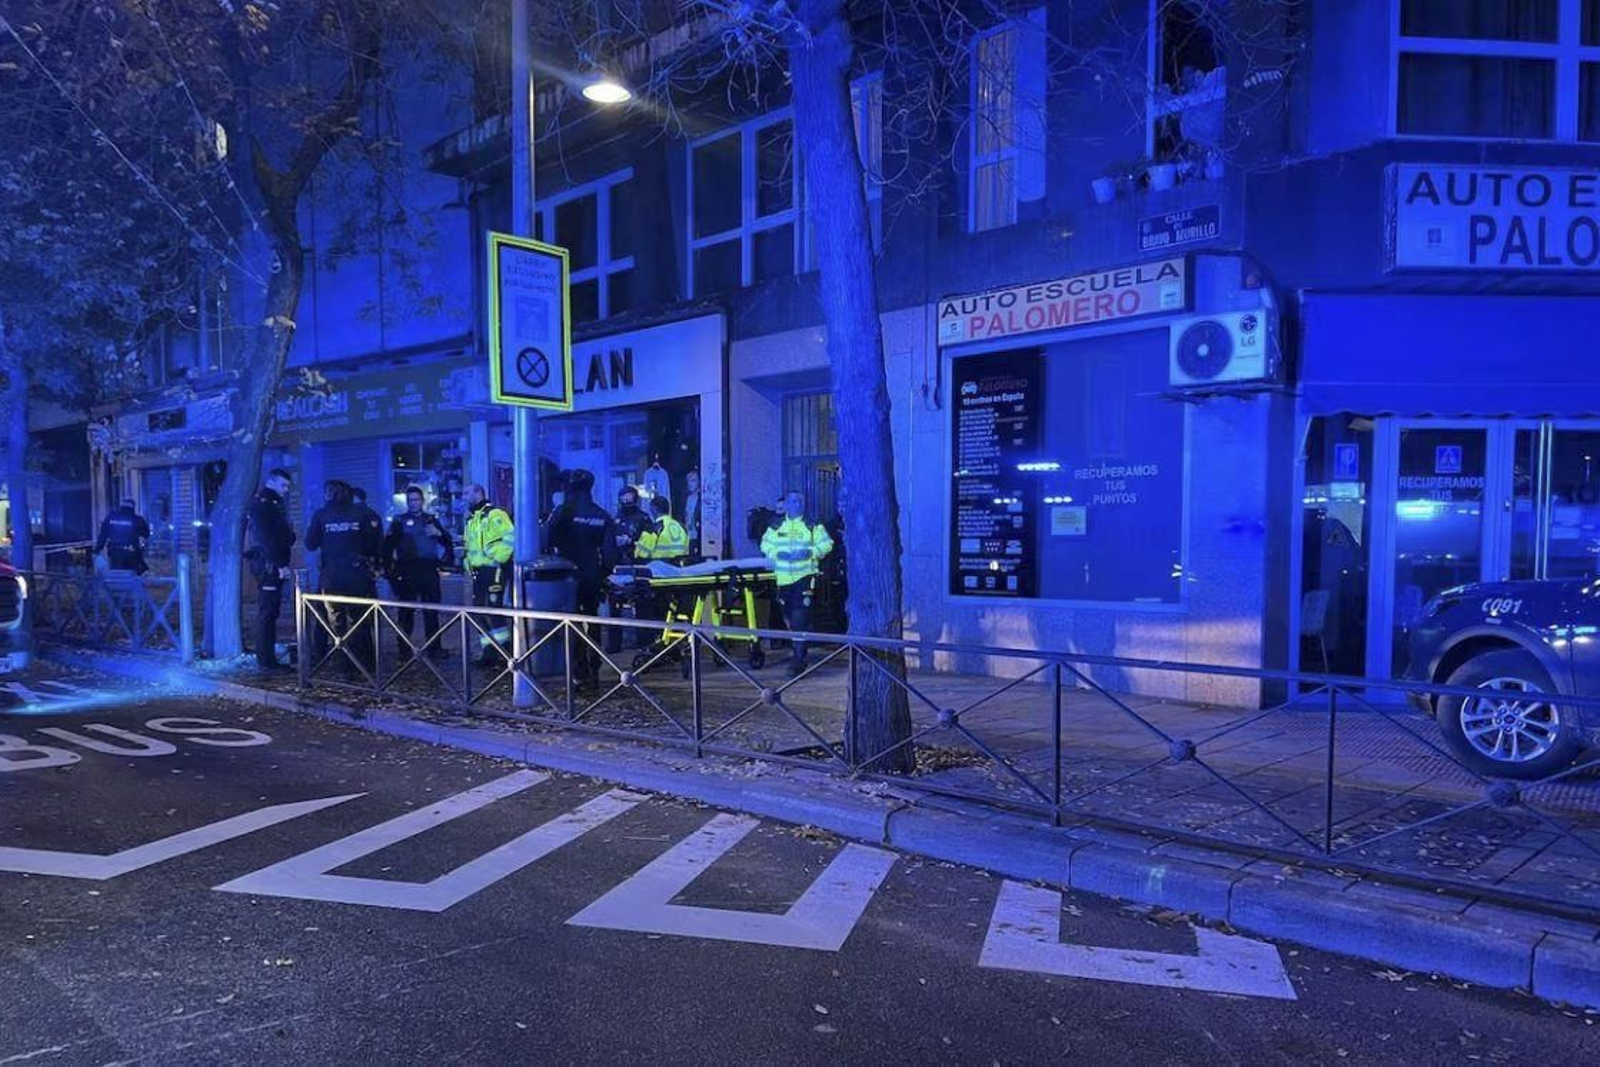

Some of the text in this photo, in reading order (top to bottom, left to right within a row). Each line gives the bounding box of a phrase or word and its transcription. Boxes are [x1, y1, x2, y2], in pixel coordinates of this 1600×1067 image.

[1405, 171, 1551, 207] AUTO
[1175, 221, 1216, 241] MURILLO
[1468, 214, 1600, 266] PALO
[940, 262, 1179, 318] AUTO ESCUELA
[969, 289, 1138, 339] PALOMERO
[1241, 335, 1256, 347] LG
[1074, 464, 1159, 480] RECUPERAMOS
[1104, 480, 1126, 491] TUS
[1399, 476, 1485, 489] RECUPERAMOS
[1093, 492, 1137, 505] PUNTOS
[0, 717, 273, 772] BUS
